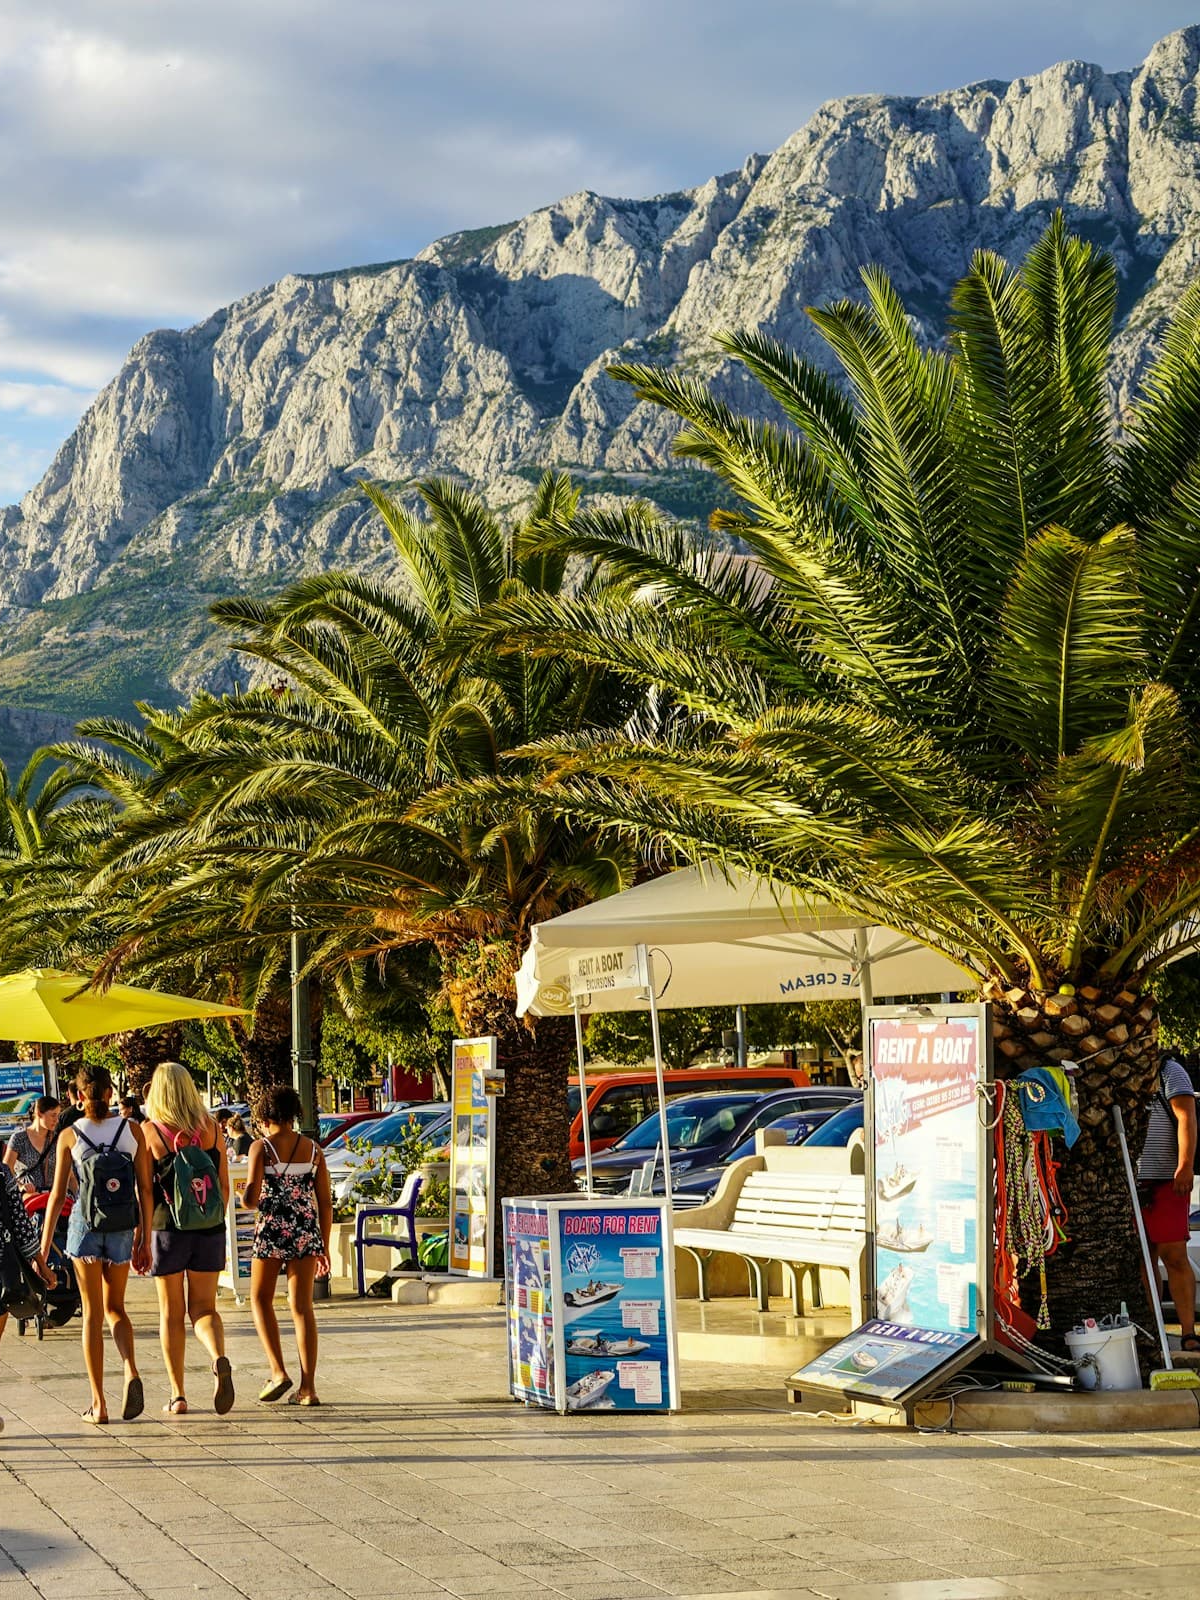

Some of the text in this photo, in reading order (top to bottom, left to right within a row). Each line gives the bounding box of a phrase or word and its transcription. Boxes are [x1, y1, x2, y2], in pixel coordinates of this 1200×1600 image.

[578, 952, 624, 976] RENT A BOAT
[586, 975, 616, 991] EXCURSIONS
[877, 1037, 973, 1064] RENT A BOAT
[565, 1215, 659, 1235] BOATS FOR RENT
[867, 1323, 960, 1345] RENT A BOAT
